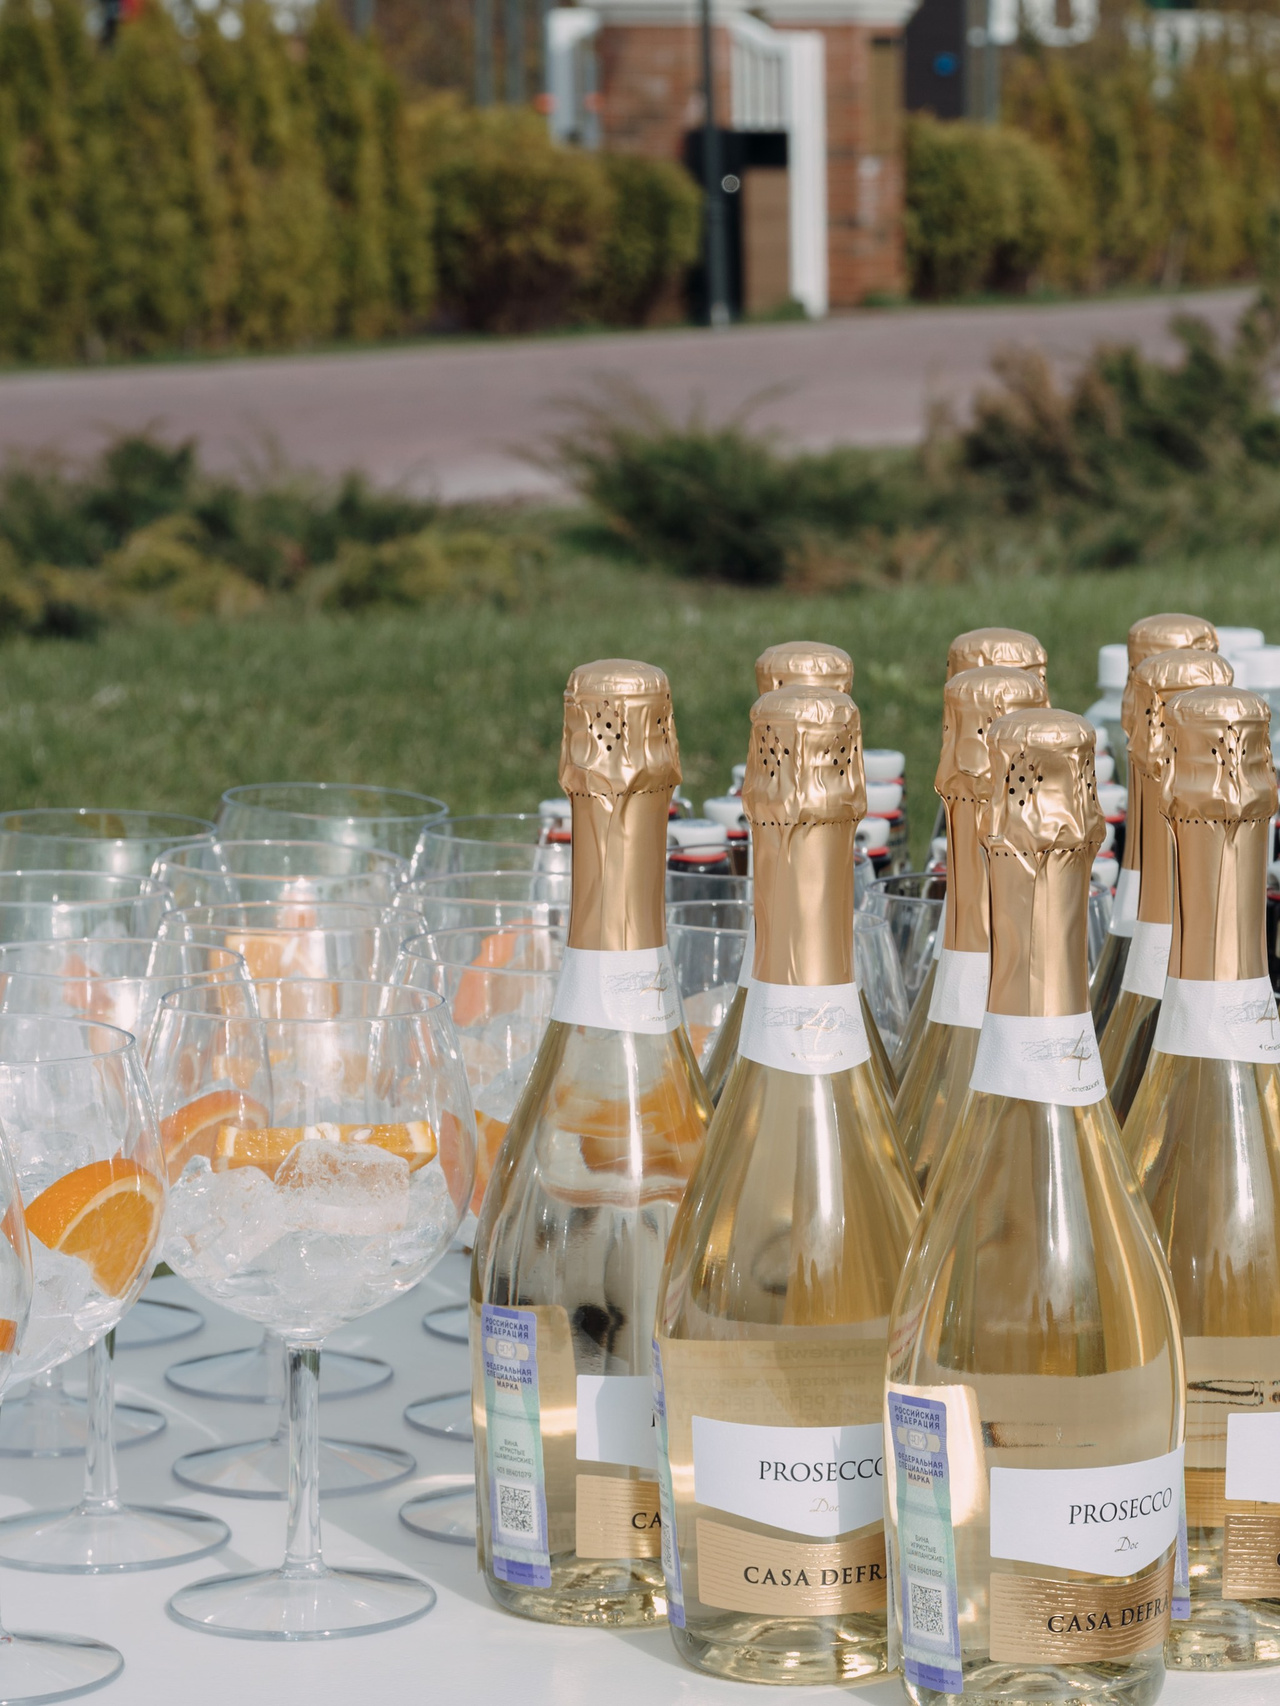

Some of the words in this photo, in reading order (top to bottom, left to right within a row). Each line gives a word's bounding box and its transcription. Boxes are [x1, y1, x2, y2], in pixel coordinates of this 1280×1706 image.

[486, 1316, 529, 1332] РОССИЙСКАЯ
[486, 1325, 529, 1340] ФЕДЕРАЦИЯ
[486, 1361, 532, 1377] ФЕДЕРАЛЬНАЯ
[486, 1369, 532, 1385] СПЕЦИАЛЬНАЯ
[496, 1380, 519, 1391] МАРКА
[894, 1405, 940, 1422] РОССИЙСКАЯ
[895, 1414, 940, 1430] ФЕДЕРАЦИЯ
[897, 1452, 943, 1470] ФЕДЕРАЛЬНАЯ
[898, 1460, 944, 1478] СПЕЦИАЛЬНАЯ
[907, 1471, 931, 1484] МАРКА
[809, 1498, 840, 1513] Doc
[1069, 1487, 1173, 1525] PROSECCO
[1114, 1536, 1139, 1552] Doc
[743, 1566, 811, 1587] CASA
[820, 1563, 887, 1586] DEFR
[1047, 1613, 1113, 1634] CASA
